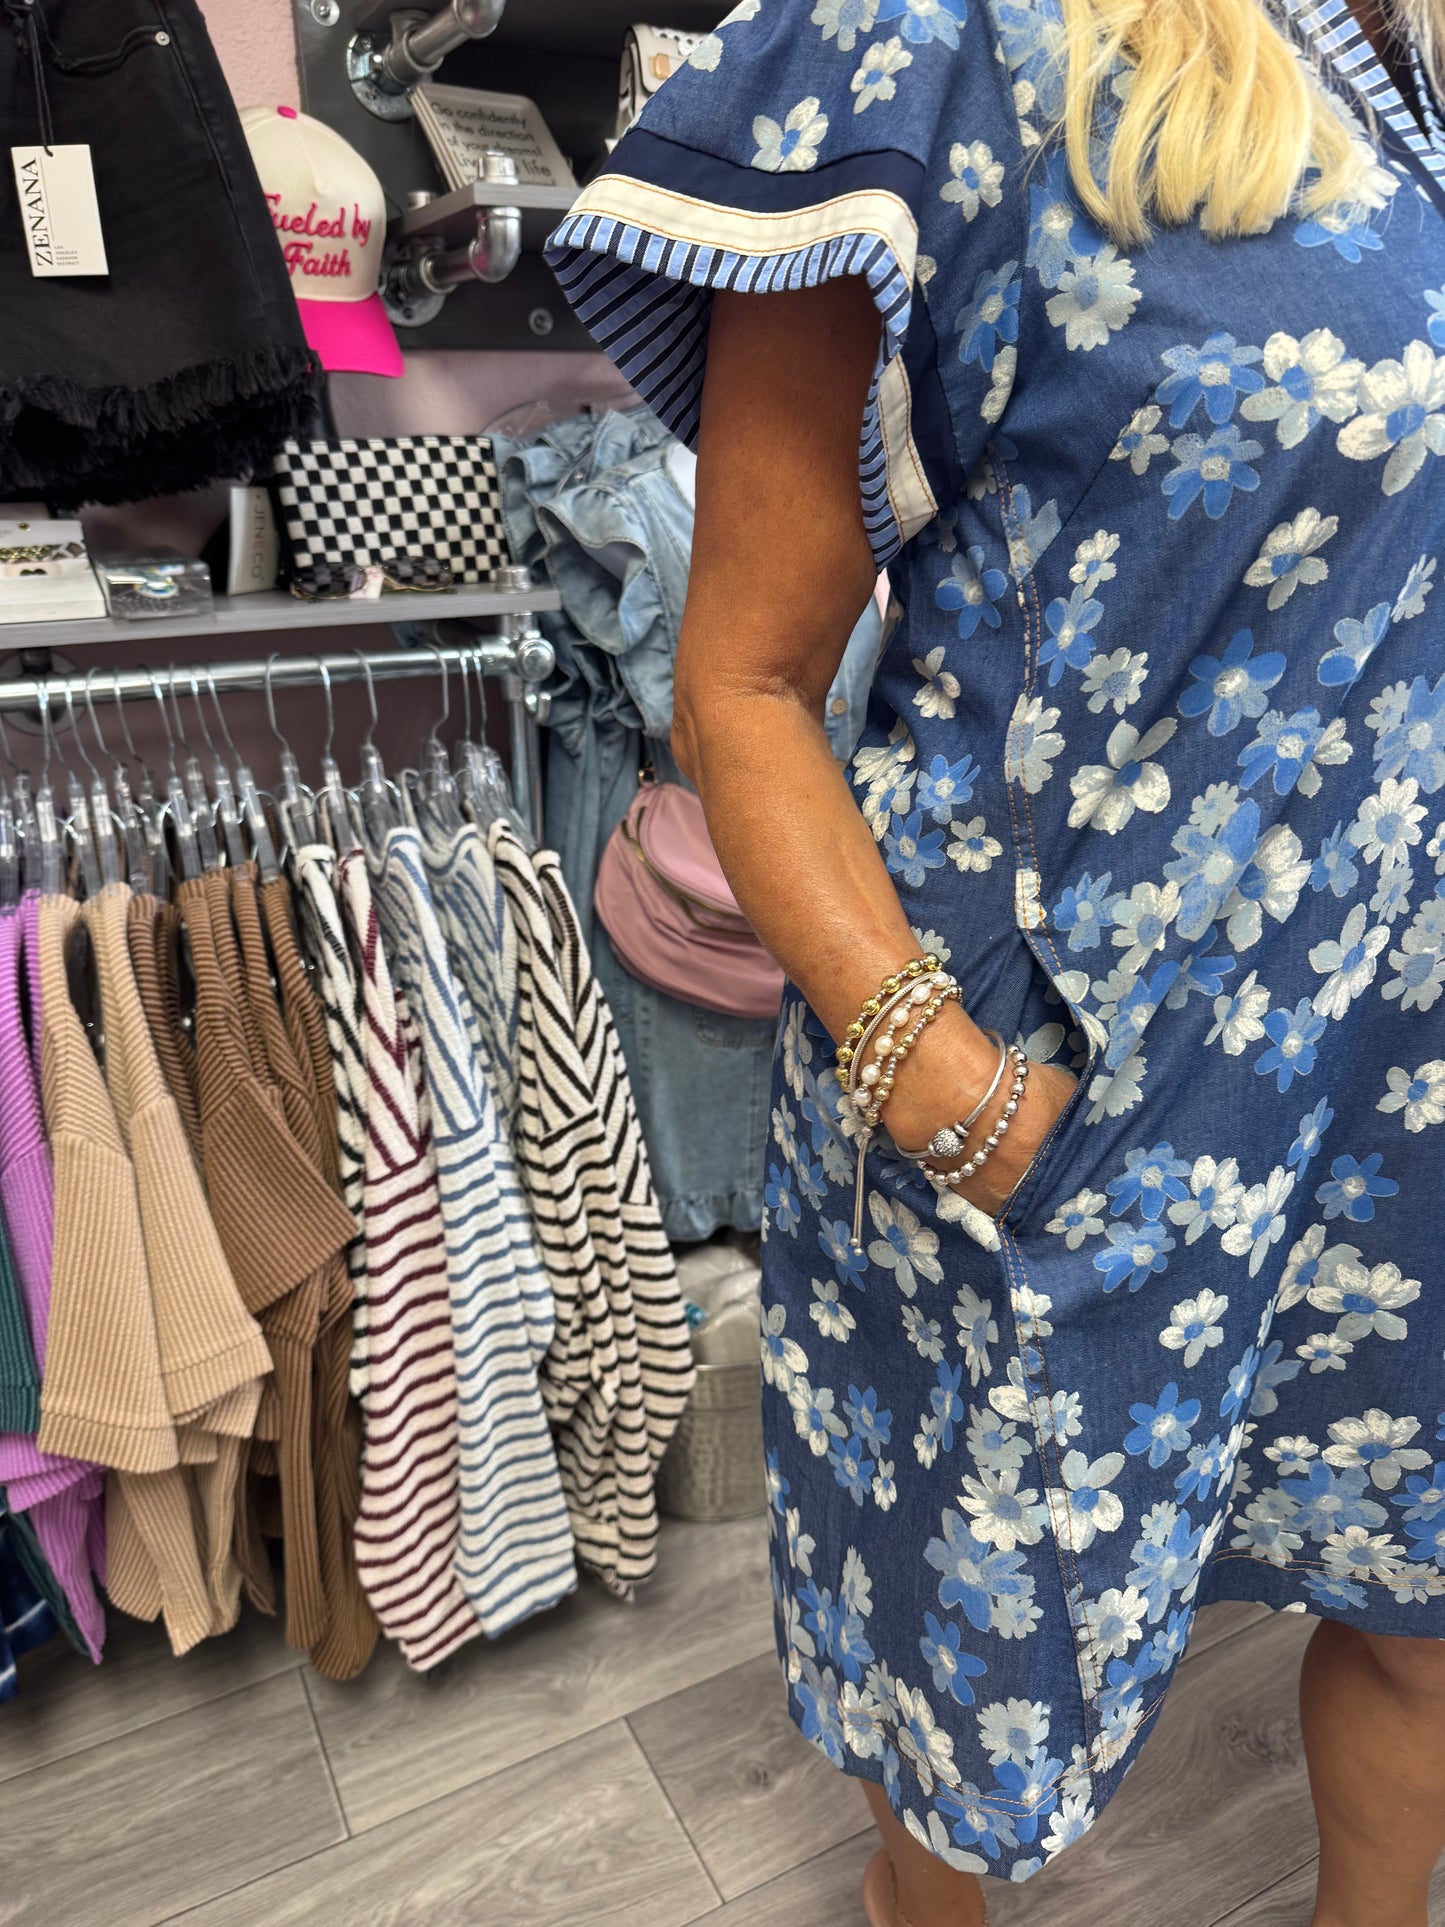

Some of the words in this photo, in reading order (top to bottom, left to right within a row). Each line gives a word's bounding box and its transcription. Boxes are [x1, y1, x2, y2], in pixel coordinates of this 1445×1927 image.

[430, 101, 453, 117] Go
[455, 107, 527, 129] confidently
[452, 120, 475, 135] the
[477, 125, 536, 142] direction
[521, 157, 552, 177] life
[20, 157, 54, 266] ZENANA
[351, 203, 372, 247] by
[283, 241, 351, 277] Faith
